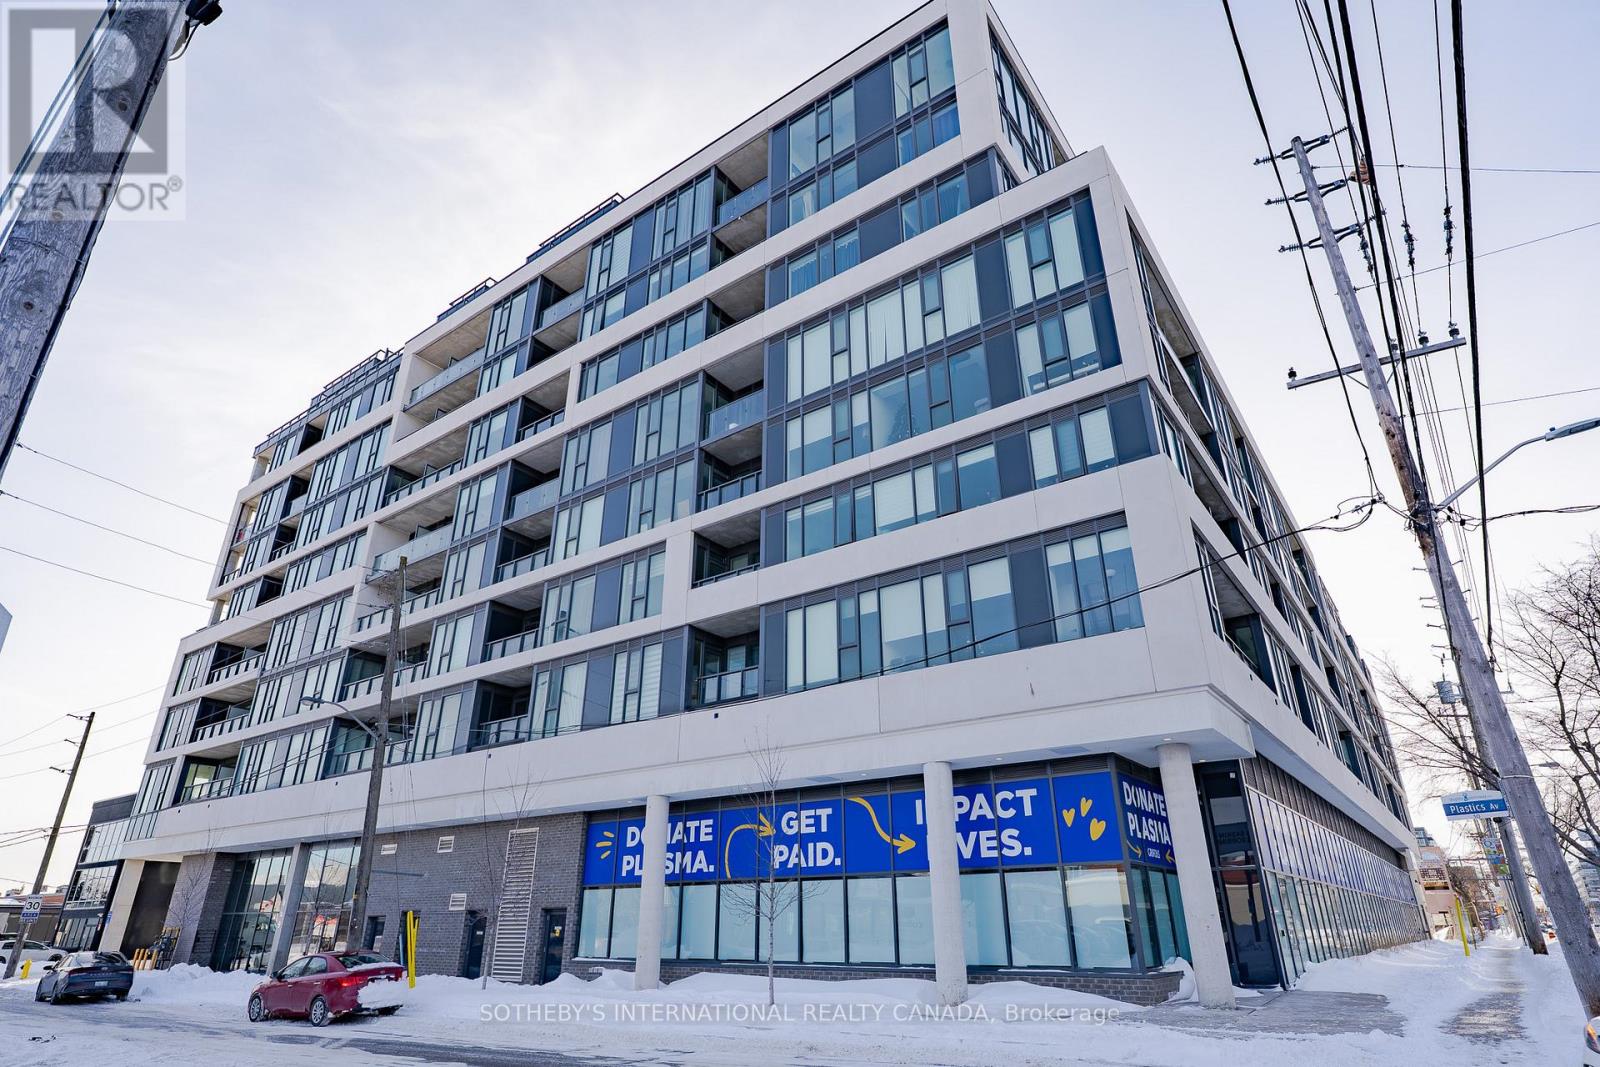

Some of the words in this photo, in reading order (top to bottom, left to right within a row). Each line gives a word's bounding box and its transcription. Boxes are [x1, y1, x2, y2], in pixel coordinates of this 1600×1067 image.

[915, 788, 1037, 825] IPACT
[1122, 781, 1167, 817] DONATE
[1450, 803, 1486, 814] Plastics
[626, 819, 713, 847] DATE
[781, 808, 832, 836] GET
[1127, 811, 1172, 846] PLASMA
[773, 842, 842, 869] PAID.
[956, 828, 1033, 859] VES.
[621, 850, 715, 877] PLSMA.
[26, 901, 41, 910] 30
